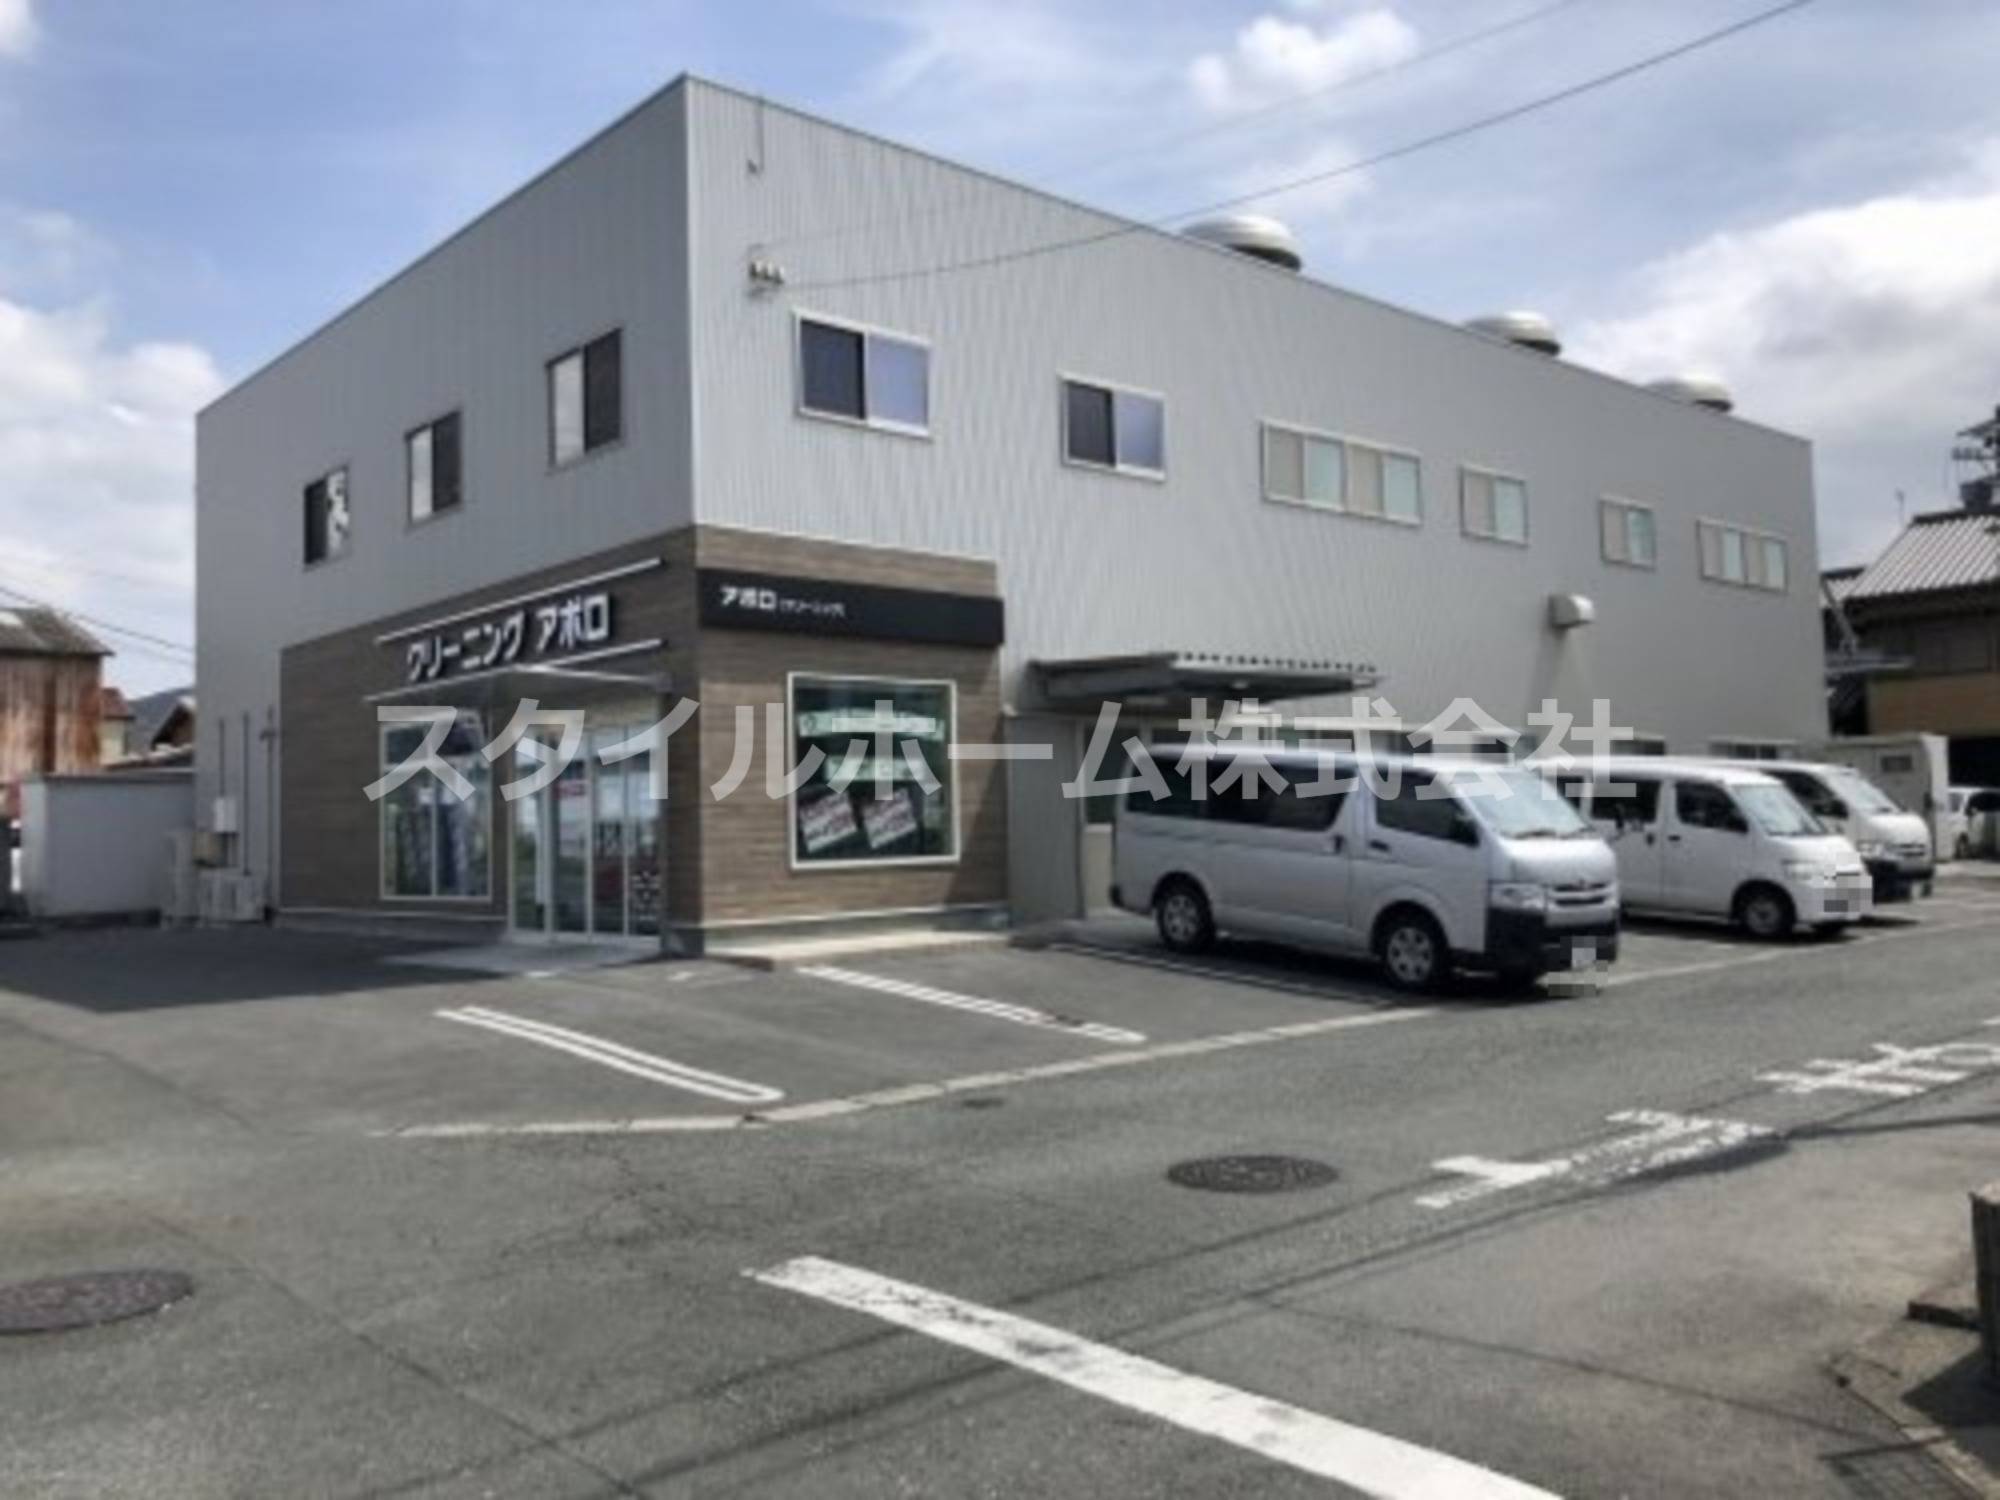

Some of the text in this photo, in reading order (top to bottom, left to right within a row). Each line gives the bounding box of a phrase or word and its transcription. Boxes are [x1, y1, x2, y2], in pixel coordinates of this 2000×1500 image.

[406, 592, 610, 682] クリーニング アポロ
[1414, 1014, 2000, 1208] 止ま
